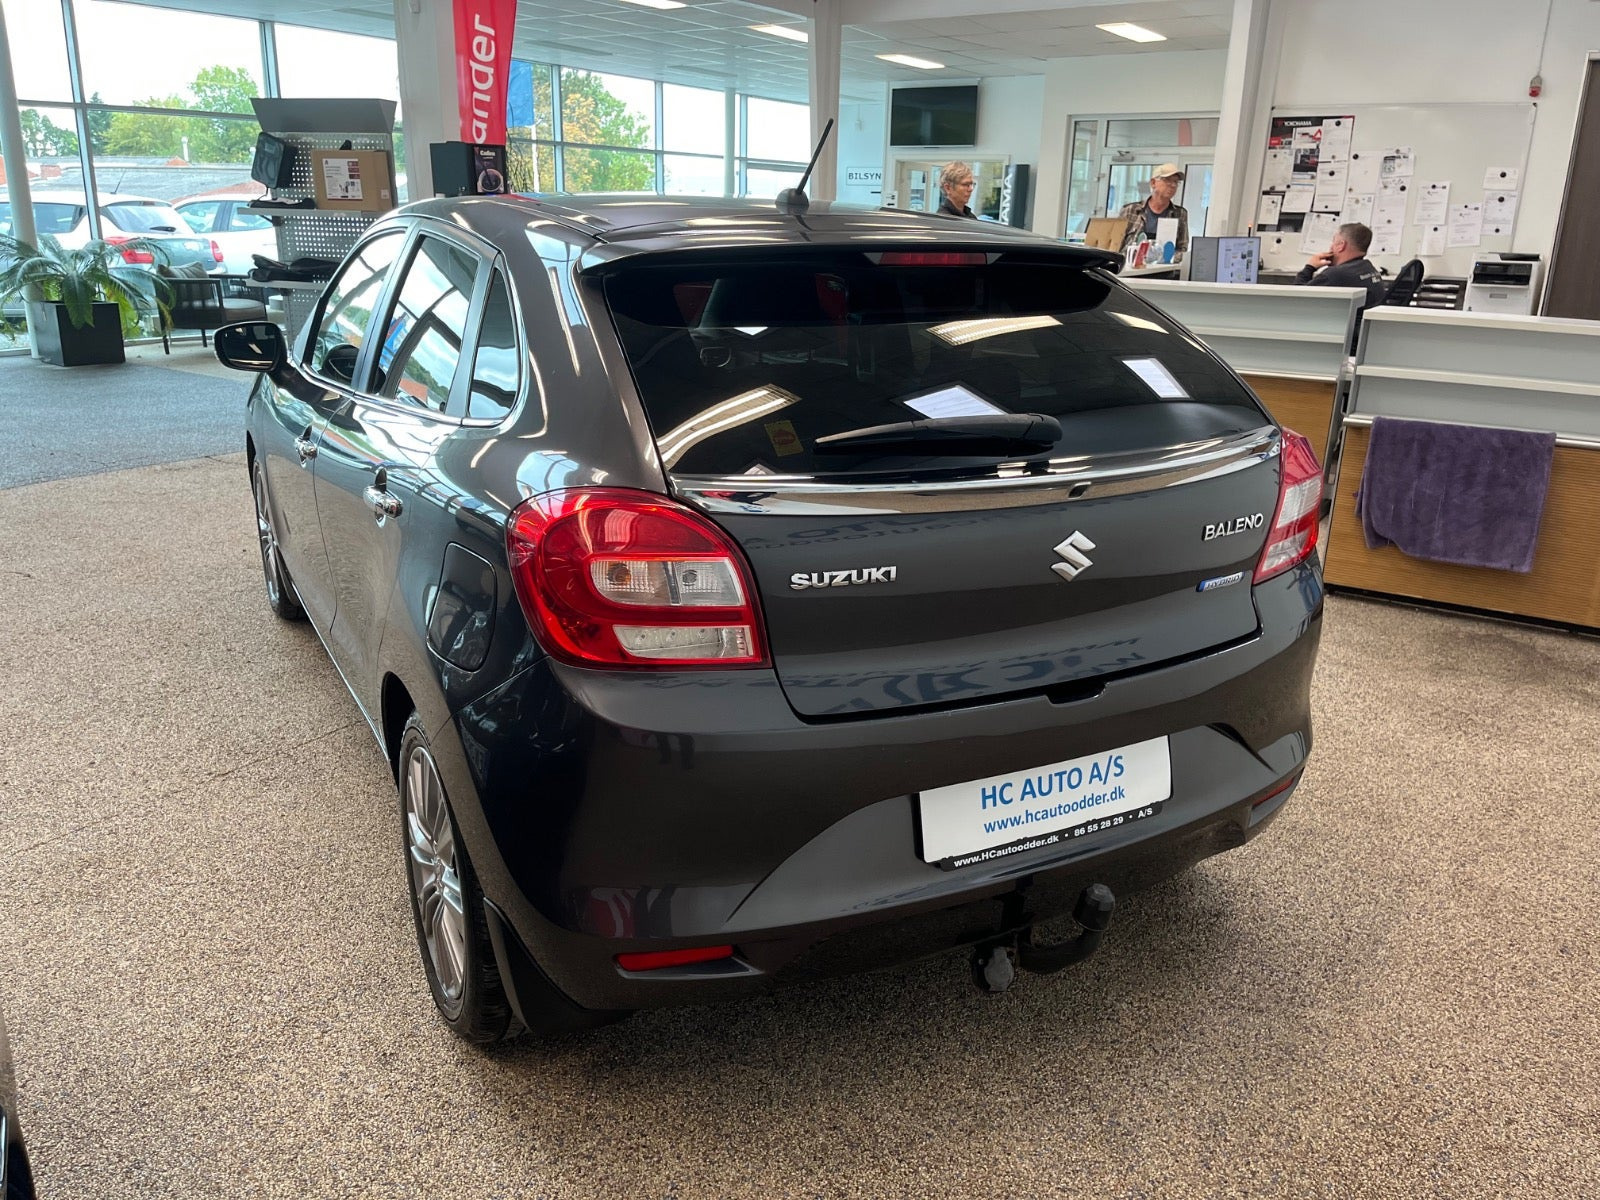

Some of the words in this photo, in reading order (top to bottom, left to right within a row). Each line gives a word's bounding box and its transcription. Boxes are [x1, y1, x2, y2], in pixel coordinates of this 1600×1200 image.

[1202, 513, 1264, 541] BALENO
[790, 566, 897, 590] SUZUKI
[1205, 574, 1240, 589] HYBRID
[981, 782, 1014, 810] HC
[1020, 767, 1083, 801] AUTO
[1088, 755, 1125, 785] A/S
[983, 785, 1126, 833] www.hcautoodder.dk
[953, 834, 1059, 868] www.HCautoodder.dk
[1074, 827, 1086, 837] 86
[1087, 823, 1099, 834] 55
[1101, 820, 1112, 830] 28
[1113, 816, 1124, 827] 29
[1137, 807, 1153, 819] A/S
